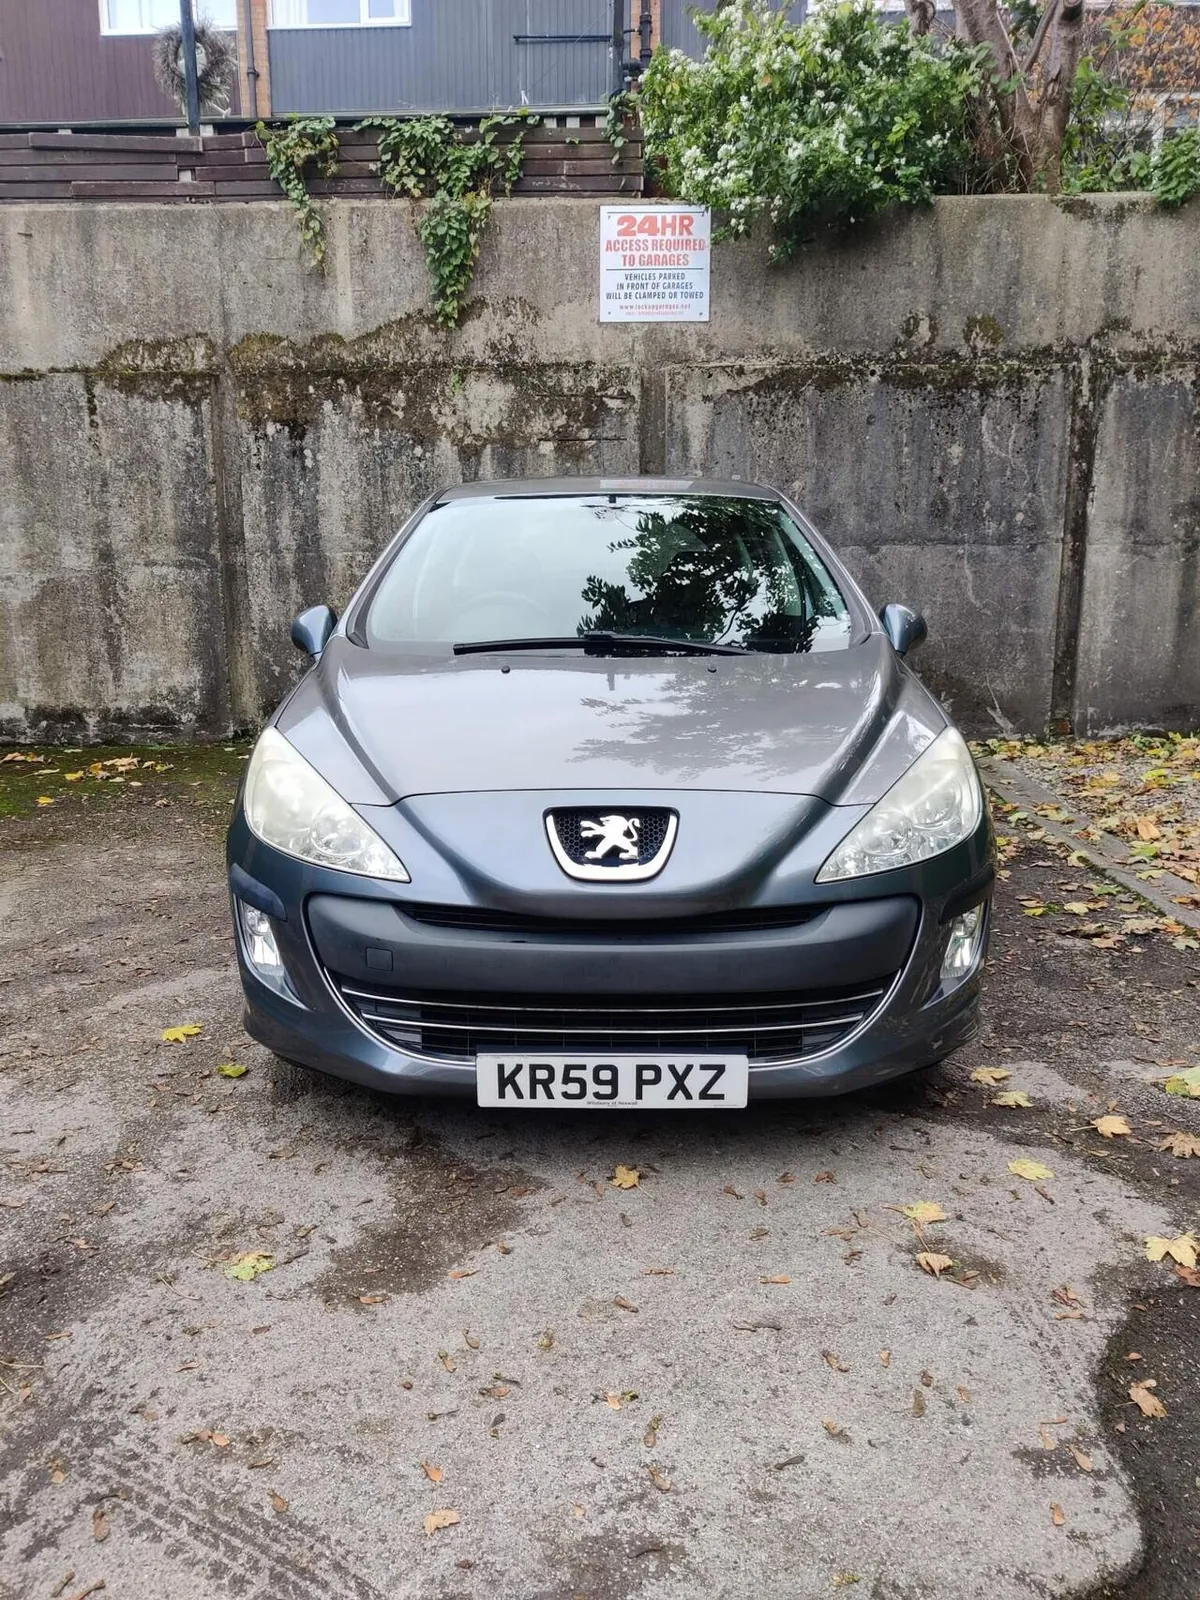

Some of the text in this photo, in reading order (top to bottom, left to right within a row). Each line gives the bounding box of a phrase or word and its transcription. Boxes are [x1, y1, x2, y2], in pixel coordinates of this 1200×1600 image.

[617, 215, 694, 236] 24HR
[606, 238, 705, 252] ACCESS REQUIRED
[622, 253, 690, 267] TO GARAGES
[625, 272, 686, 281] VEHICLES PARKED
[626, 282, 648, 290] FRONT
[651, 282, 660, 290] OF
[662, 282, 693, 290] GARAGES
[680, 291, 704, 299] TOWED
[497, 1063, 726, 1100] KR59 PXZ
